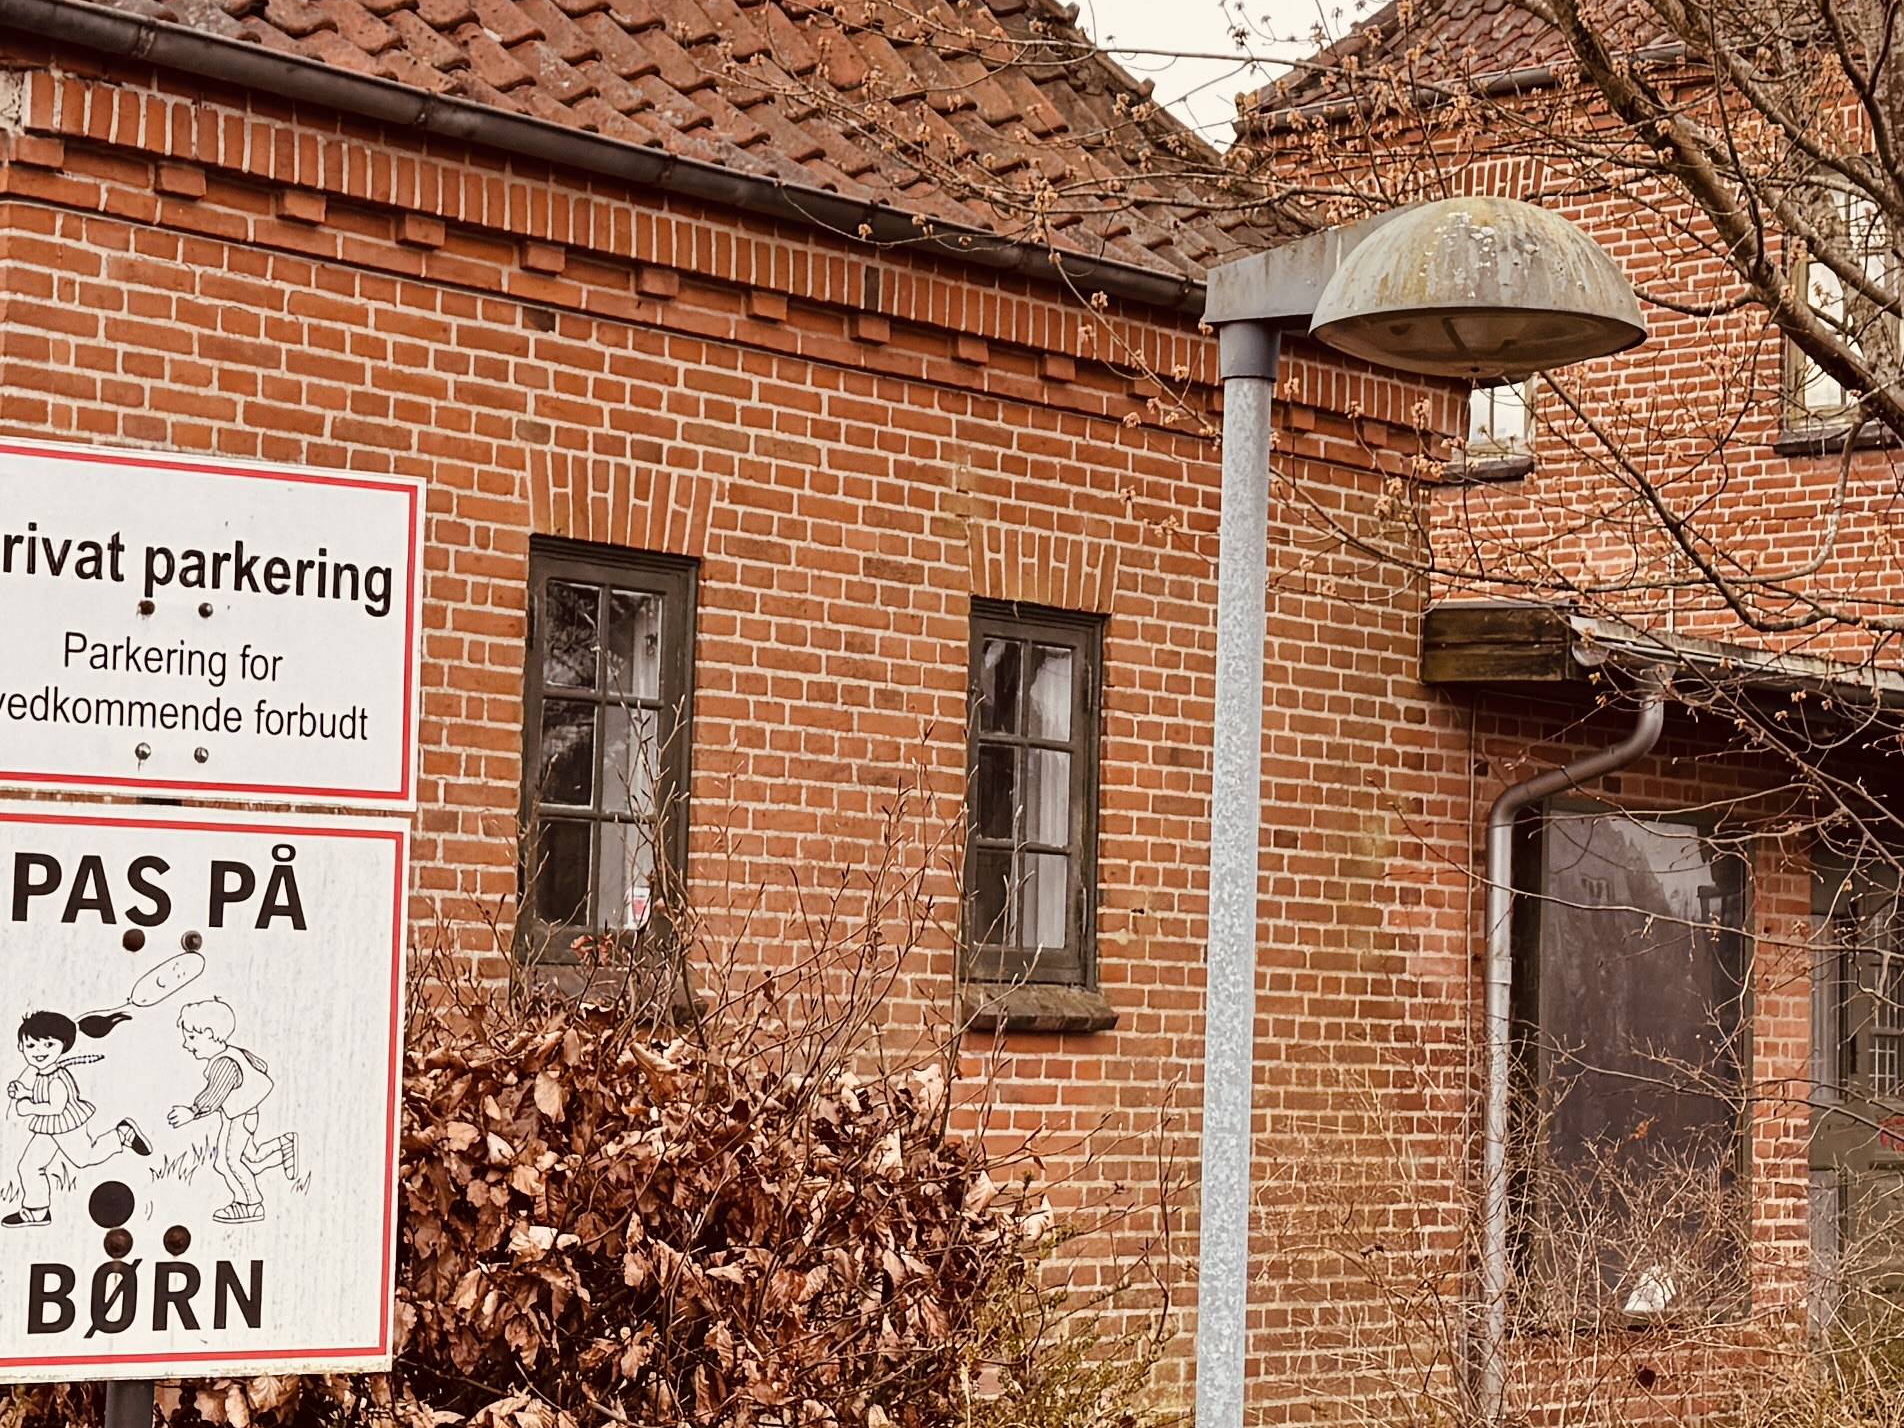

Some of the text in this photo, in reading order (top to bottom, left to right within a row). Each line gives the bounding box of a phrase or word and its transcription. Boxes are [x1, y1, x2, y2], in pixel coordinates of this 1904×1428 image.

[143, 539, 393, 619] parkering
[63, 630, 284, 689] Parkering for
[254, 698, 370, 742] forbudt
[10, 843, 308, 932] PAS PÅ
[26, 1257, 265, 1340] BØRN
